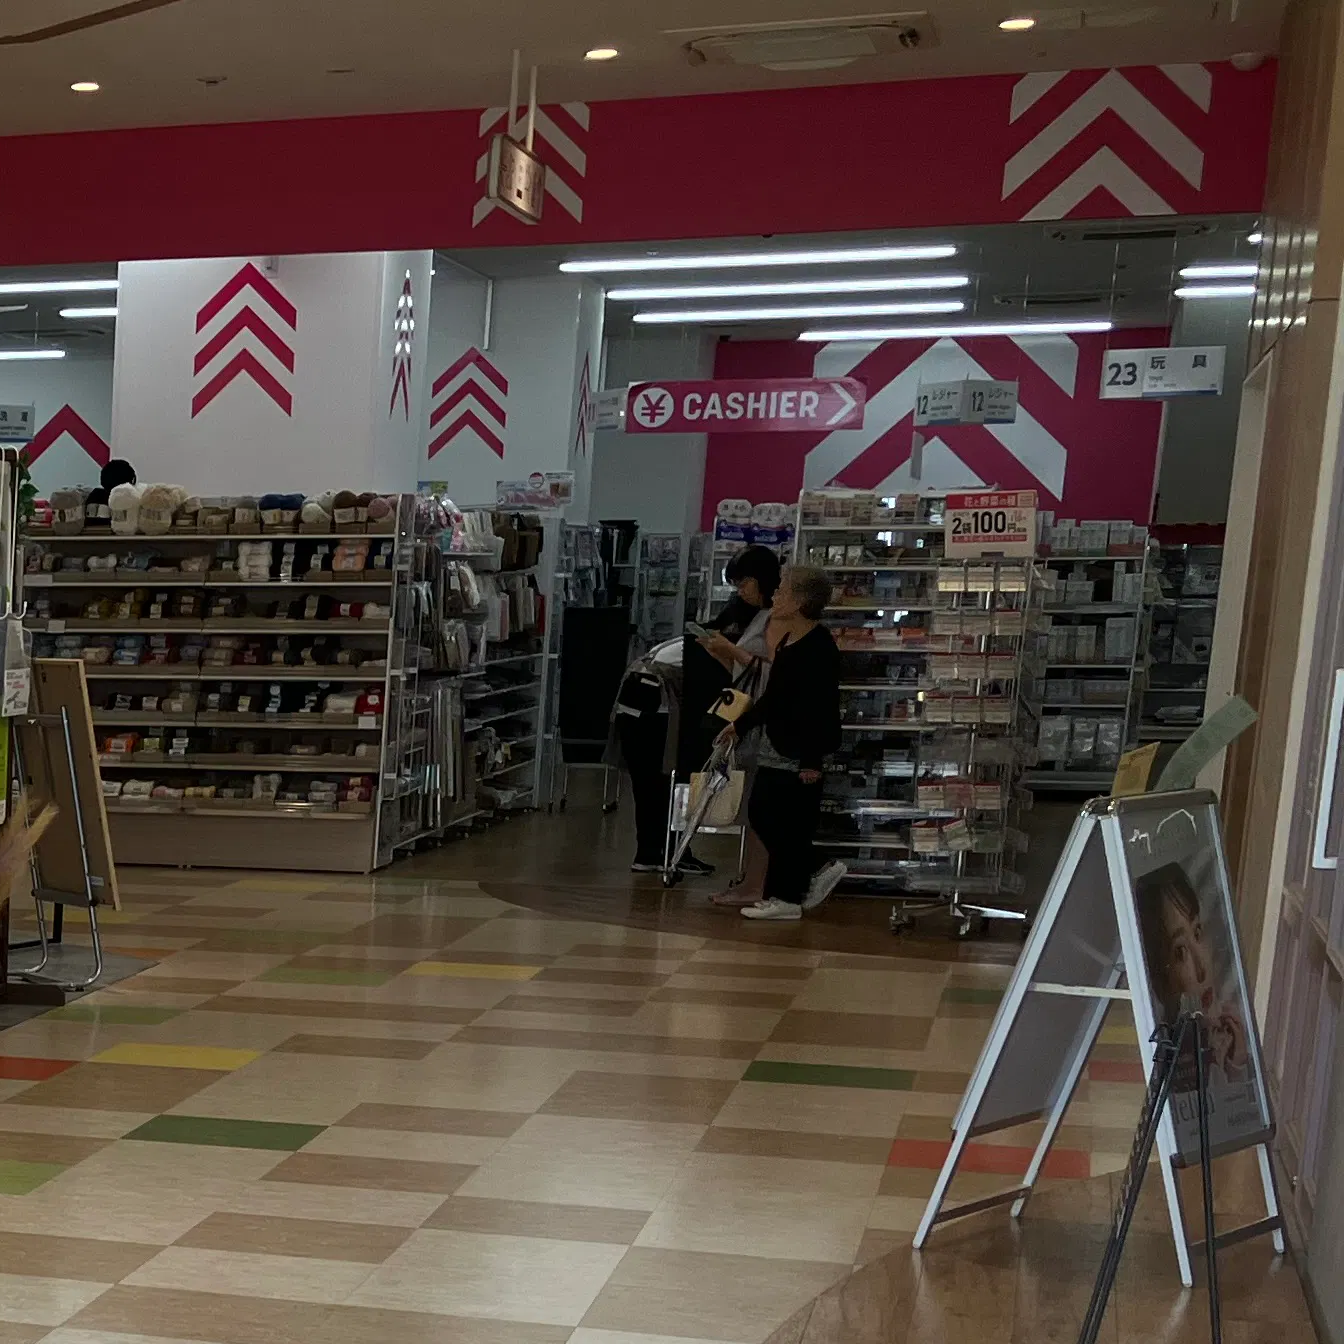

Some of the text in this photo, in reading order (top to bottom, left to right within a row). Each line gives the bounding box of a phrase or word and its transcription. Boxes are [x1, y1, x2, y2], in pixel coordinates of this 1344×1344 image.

[1106, 362, 1138, 387] 23
[683, 390, 820, 421] CASHIER
[917, 395, 929, 415] 12
[972, 391, 984, 412] 12
